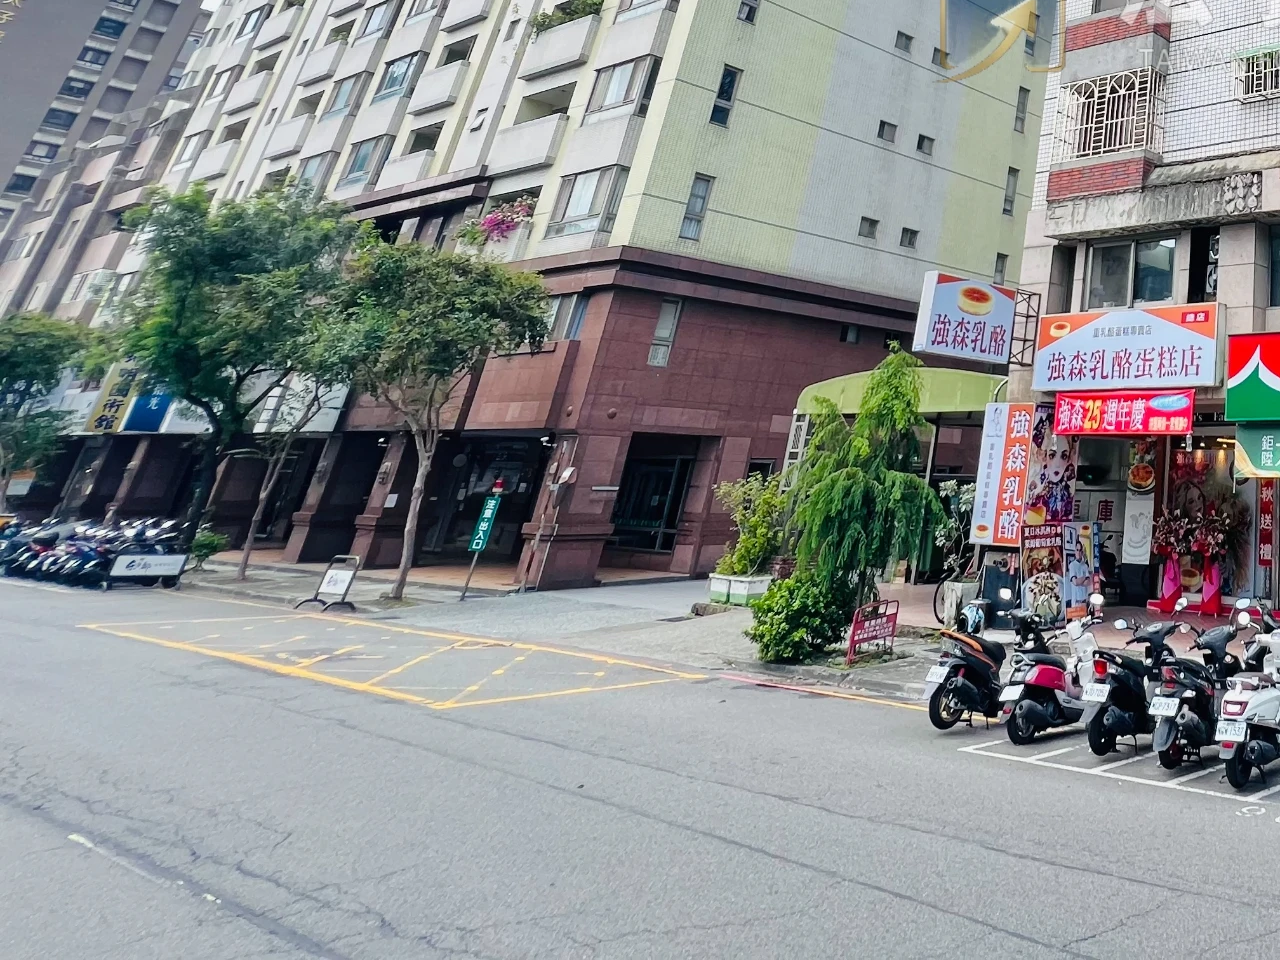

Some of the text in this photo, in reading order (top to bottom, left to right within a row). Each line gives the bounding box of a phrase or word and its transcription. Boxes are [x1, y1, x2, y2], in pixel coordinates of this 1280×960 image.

[931, 313, 1007, 357] 強森乳酪
[1047, 345, 1203, 382] 強森乳酪蛋糕店
[1058, 397, 1147, 431] 強森25週年慶
[998, 410, 1031, 539] 強森乳酪
[1260, 487, 1273, 560] 秋送禮
